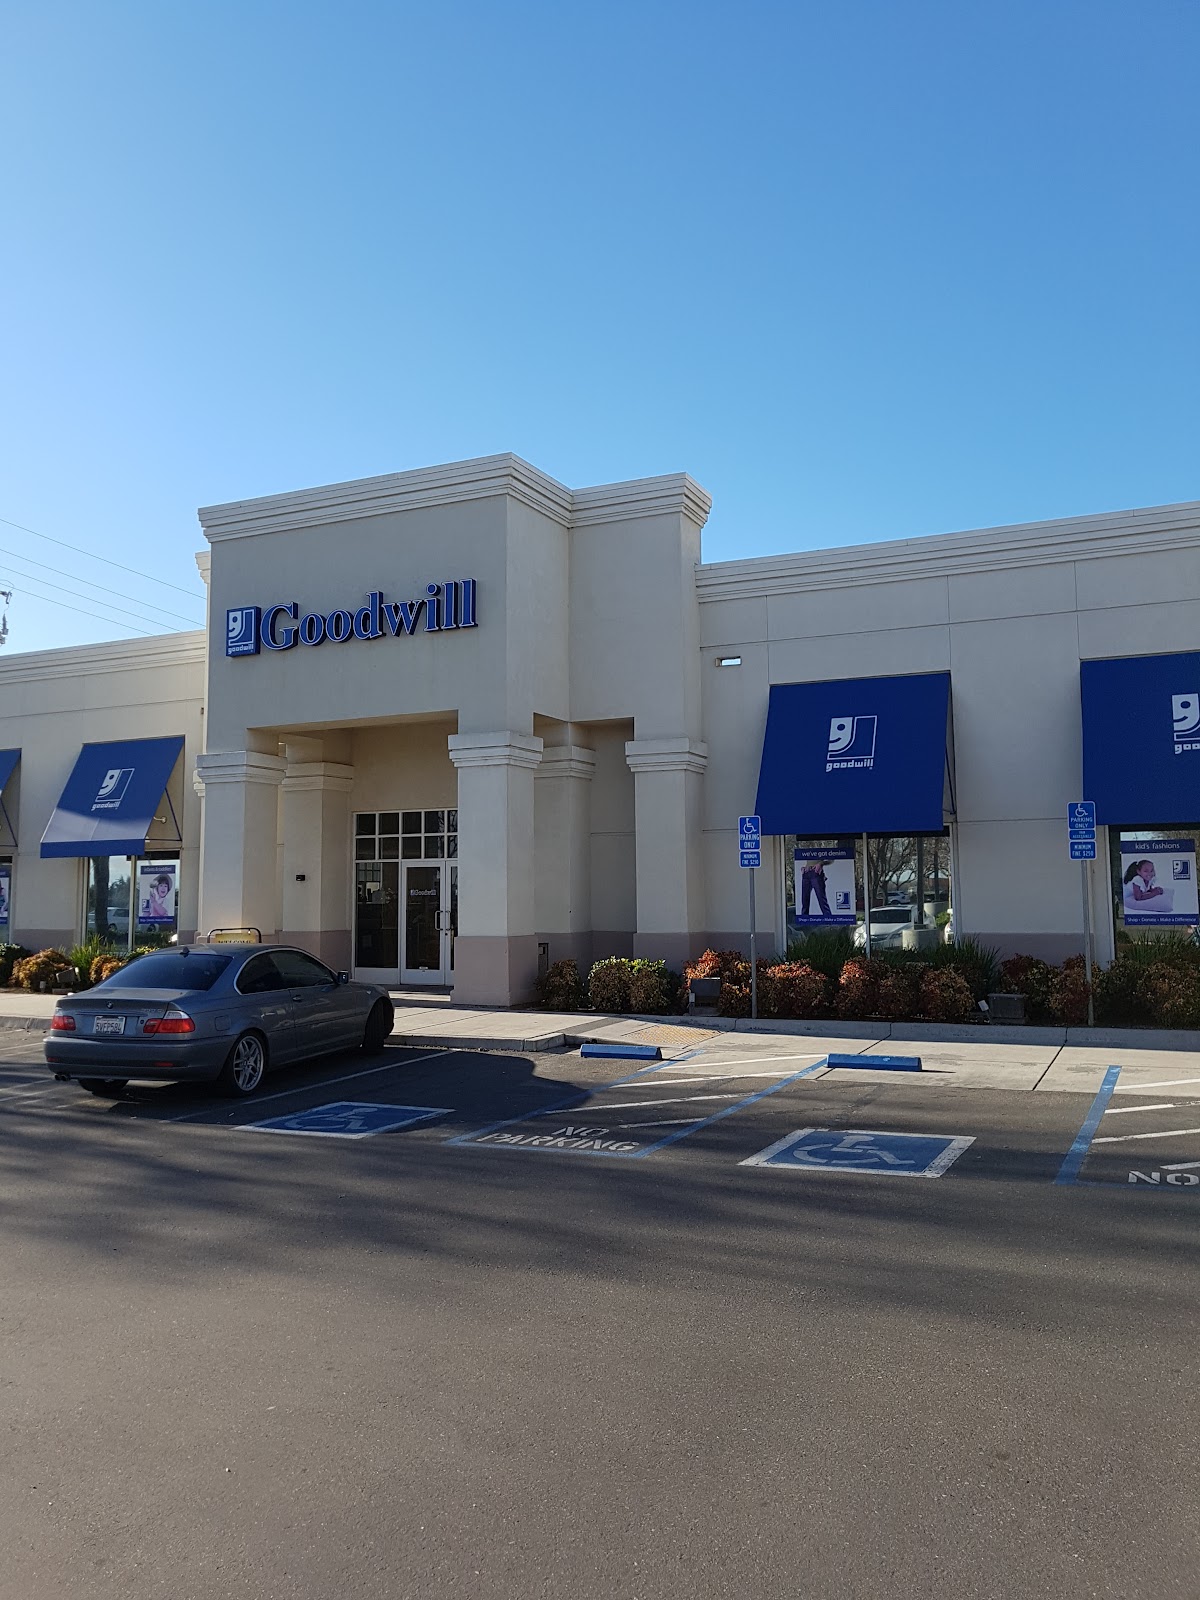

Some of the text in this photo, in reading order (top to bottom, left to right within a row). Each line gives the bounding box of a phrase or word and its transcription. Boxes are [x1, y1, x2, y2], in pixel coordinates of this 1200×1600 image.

[260, 578, 477, 650] Goodwill
[228, 643, 254, 655] goodwill
[825, 758, 874, 772] goodwill
[91, 801, 120, 811] goodwill
[739, 833, 760, 841] PARKING
[743, 841, 756, 849] ONLY
[1152, 842, 1180, 850] fashions
[552, 1126, 610, 1137] NO
[476, 1133, 640, 1151] PARKING
[1127, 1170, 1200, 1186] NO
